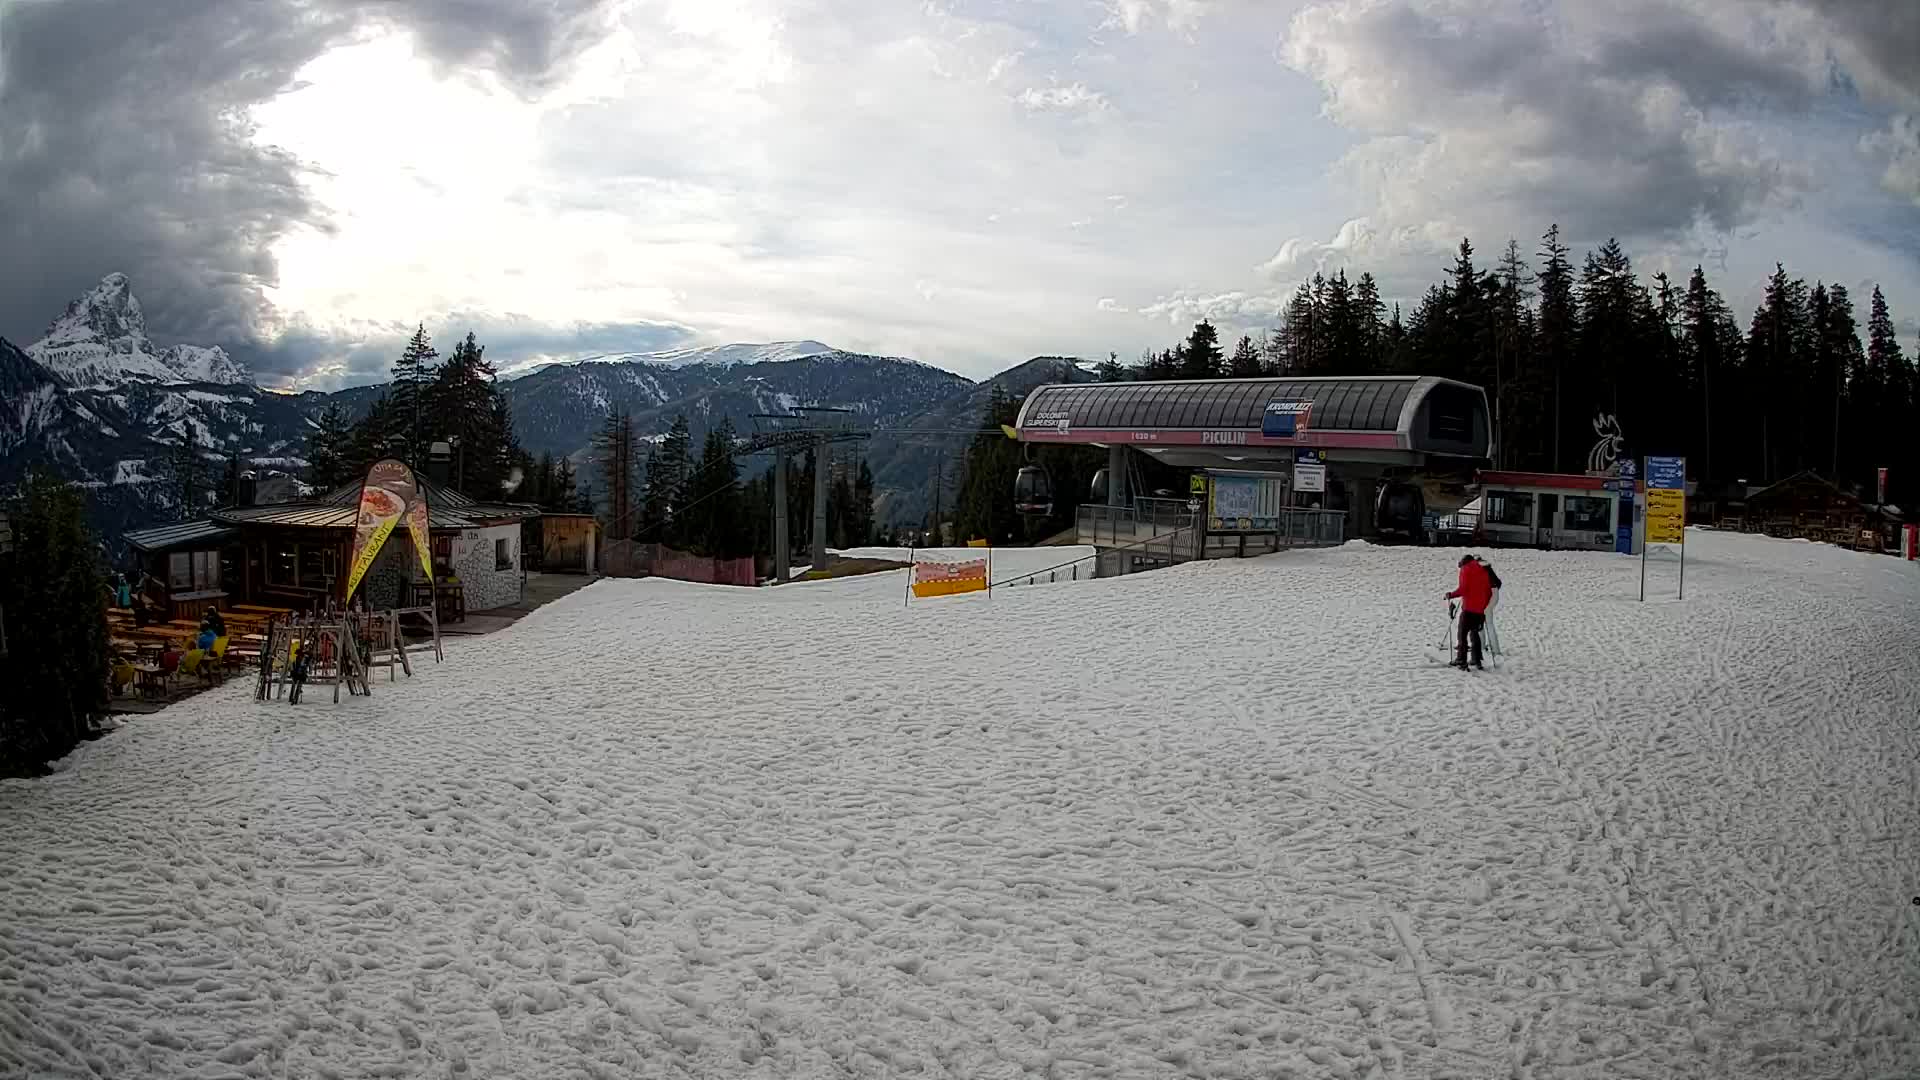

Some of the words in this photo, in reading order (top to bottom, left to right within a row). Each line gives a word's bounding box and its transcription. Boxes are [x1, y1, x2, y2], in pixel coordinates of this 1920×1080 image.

[1036, 411, 1069, 419] DOLOMITI
[1026, 419, 1059, 427] SUPERSKI
[1202, 431, 1246, 444] PICULIN
